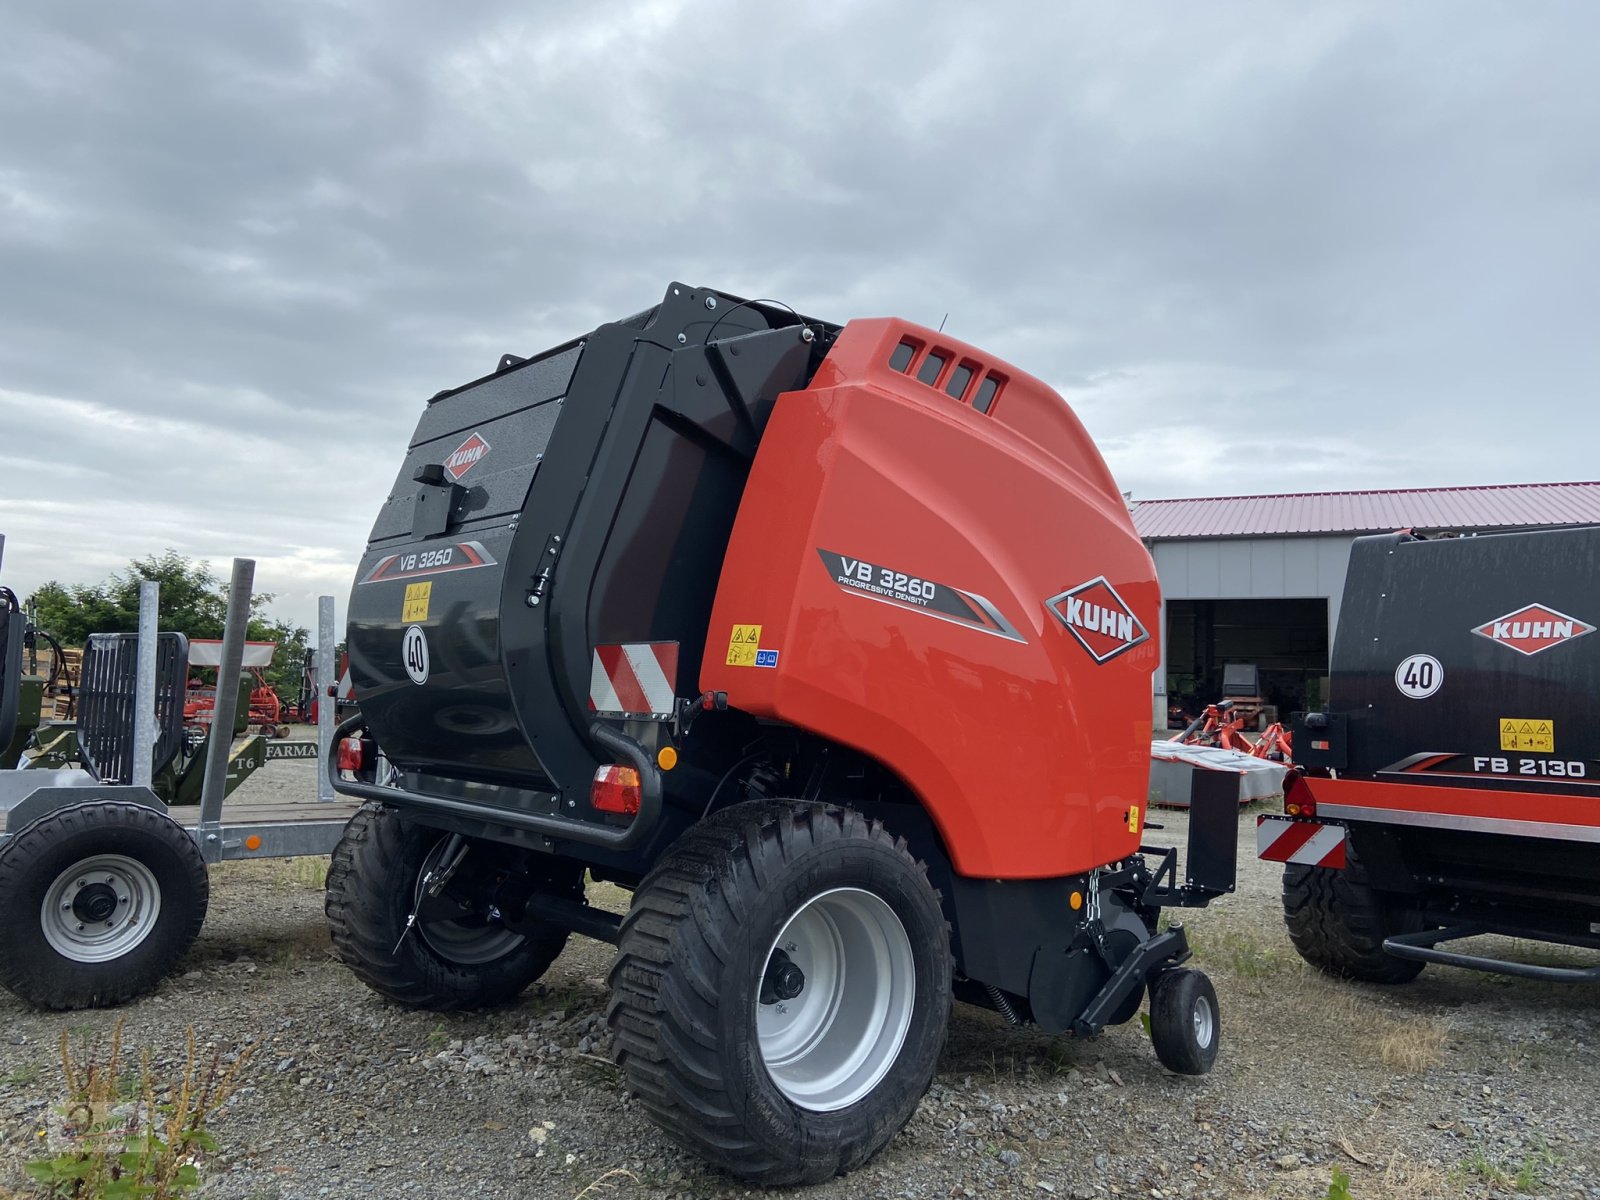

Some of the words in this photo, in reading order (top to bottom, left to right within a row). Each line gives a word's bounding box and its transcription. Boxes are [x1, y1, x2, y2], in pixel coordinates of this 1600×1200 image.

[448, 444, 485, 468] KUHN
[400, 554, 416, 571] VB
[418, 548, 453, 568] 3260
[841, 556, 872, 582] VB
[880, 569, 935, 600] 3260
[838, 575, 894, 597] PROGRESSIVE
[895, 591, 928, 606] DENSITY
[1066, 596, 1133, 642] KUHN
[1492, 621, 1574, 639] KUHN
[408, 635, 424, 672] 40
[1403, 662, 1433, 689] 40
[47, 750, 67, 762] T6
[235, 757, 255, 769] T6
[265, 745, 317, 758] FARMA
[1473, 756, 1508, 773] FB
[1519, 758, 1585, 777] 2130
